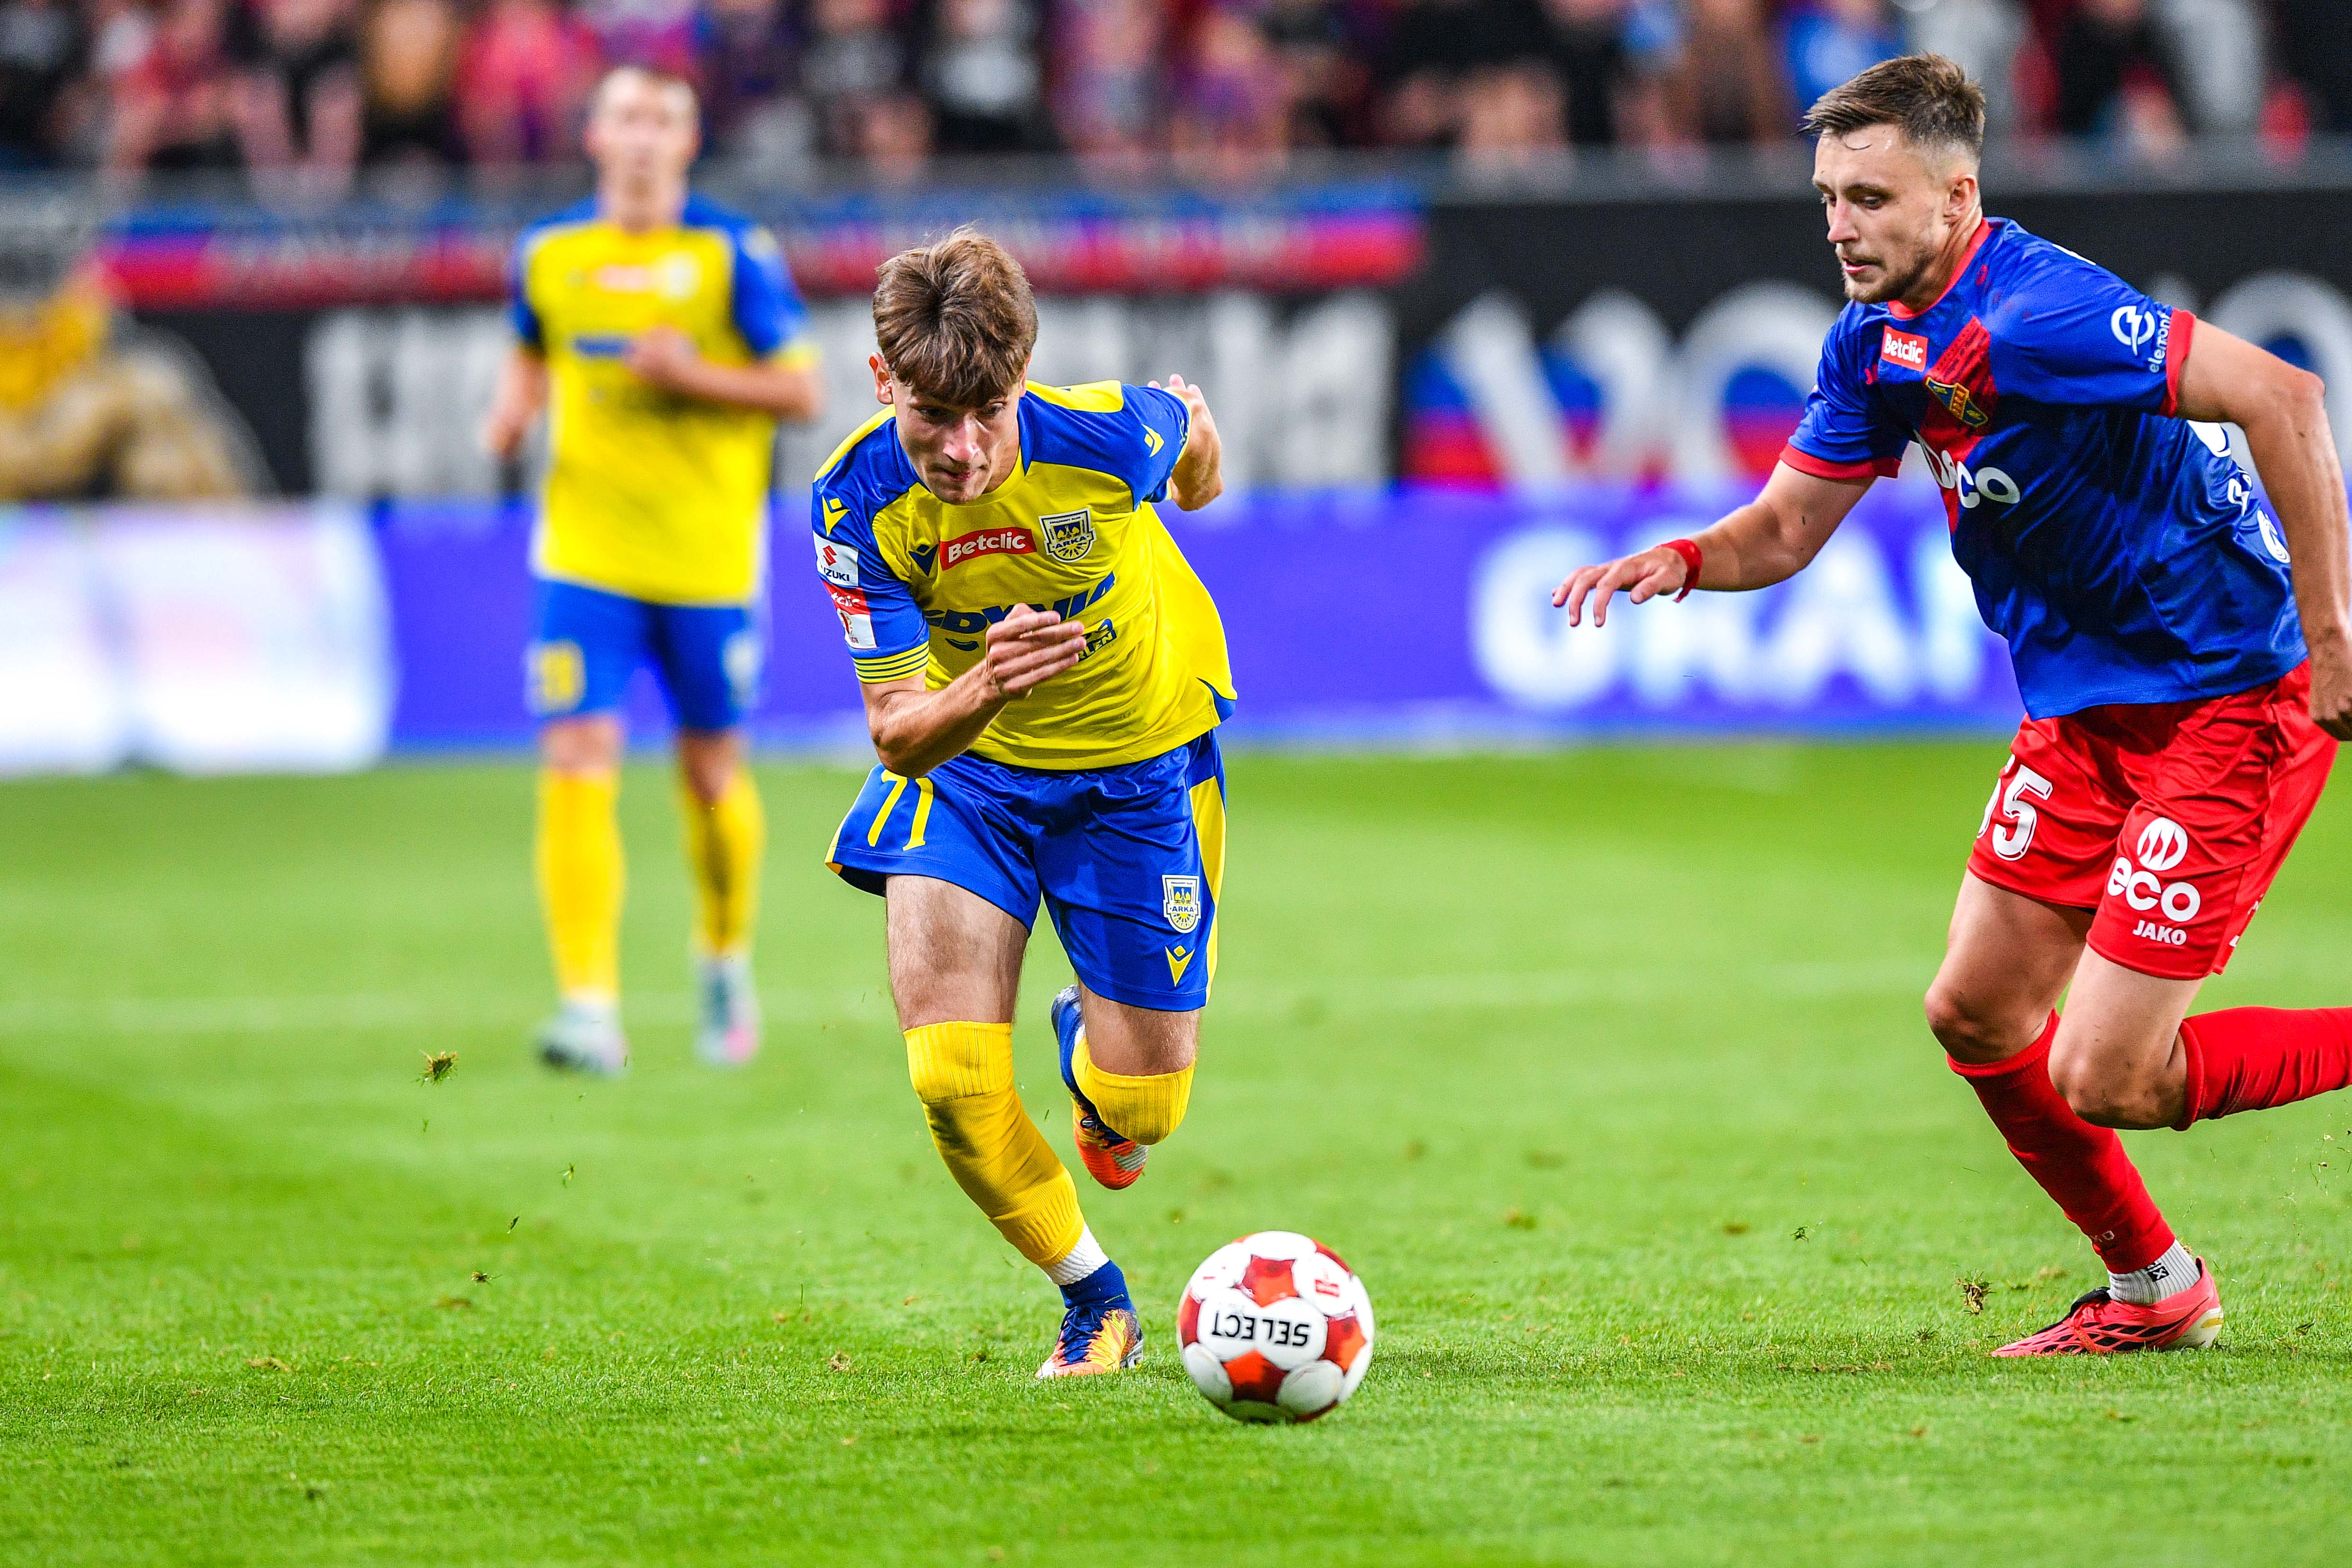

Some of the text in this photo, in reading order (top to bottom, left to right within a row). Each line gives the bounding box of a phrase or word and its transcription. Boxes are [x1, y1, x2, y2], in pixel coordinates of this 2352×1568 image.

[1884, 333, 1923, 363] Betclic
[948, 532, 1026, 563] Betclic
[1055, 536, 1086, 549] ARKA
[821, 565, 850, 581] ZUKI
[831, 592, 860, 607] tclic
[1077, 632, 1115, 661] RLEN
[867, 769, 934, 852] 71
[2107, 856, 2201, 922] eco
[2132, 920, 2187, 945] JAKO
[1212, 1310, 1311, 1347] SELECT
